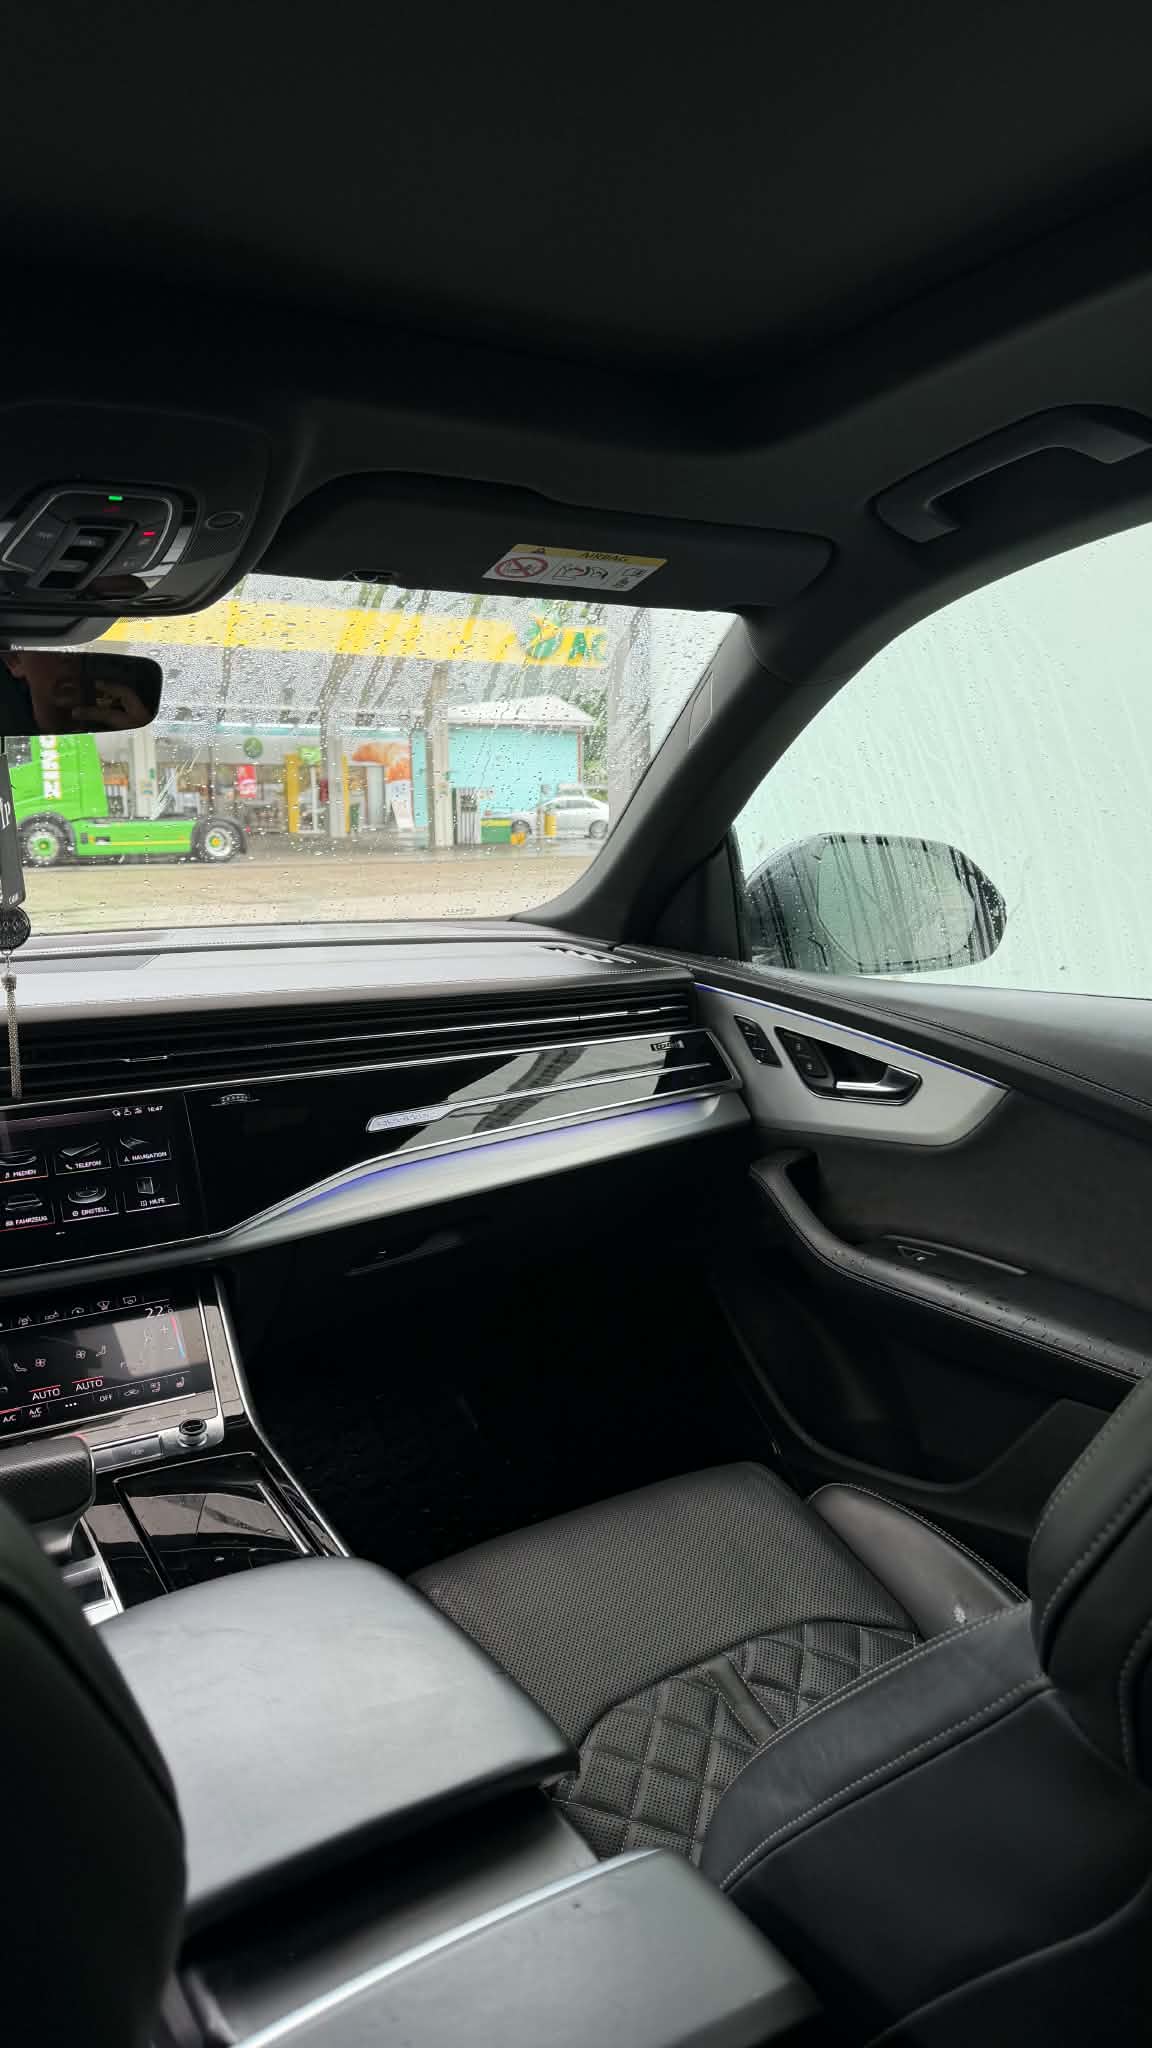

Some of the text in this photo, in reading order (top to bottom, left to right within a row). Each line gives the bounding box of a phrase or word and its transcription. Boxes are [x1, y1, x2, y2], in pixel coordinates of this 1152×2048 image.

[580, 551, 627, 562] AIRBAG
[131, 1151, 168, 1161] NAVIGATION
[75, 1159, 102, 1169] TELEFON
[12, 1169, 37, 1177] MEDIEN
[15, 1215, 48, 1225] FAHRZEUG
[75, 1379, 104, 1392] AUTO
[32, 1388, 61, 1401] AUTO
[99, 1393, 113, 1402] OFF
[28, 1407, 42, 1416] A/C
[2, 1414, 17, 1424] A/C
